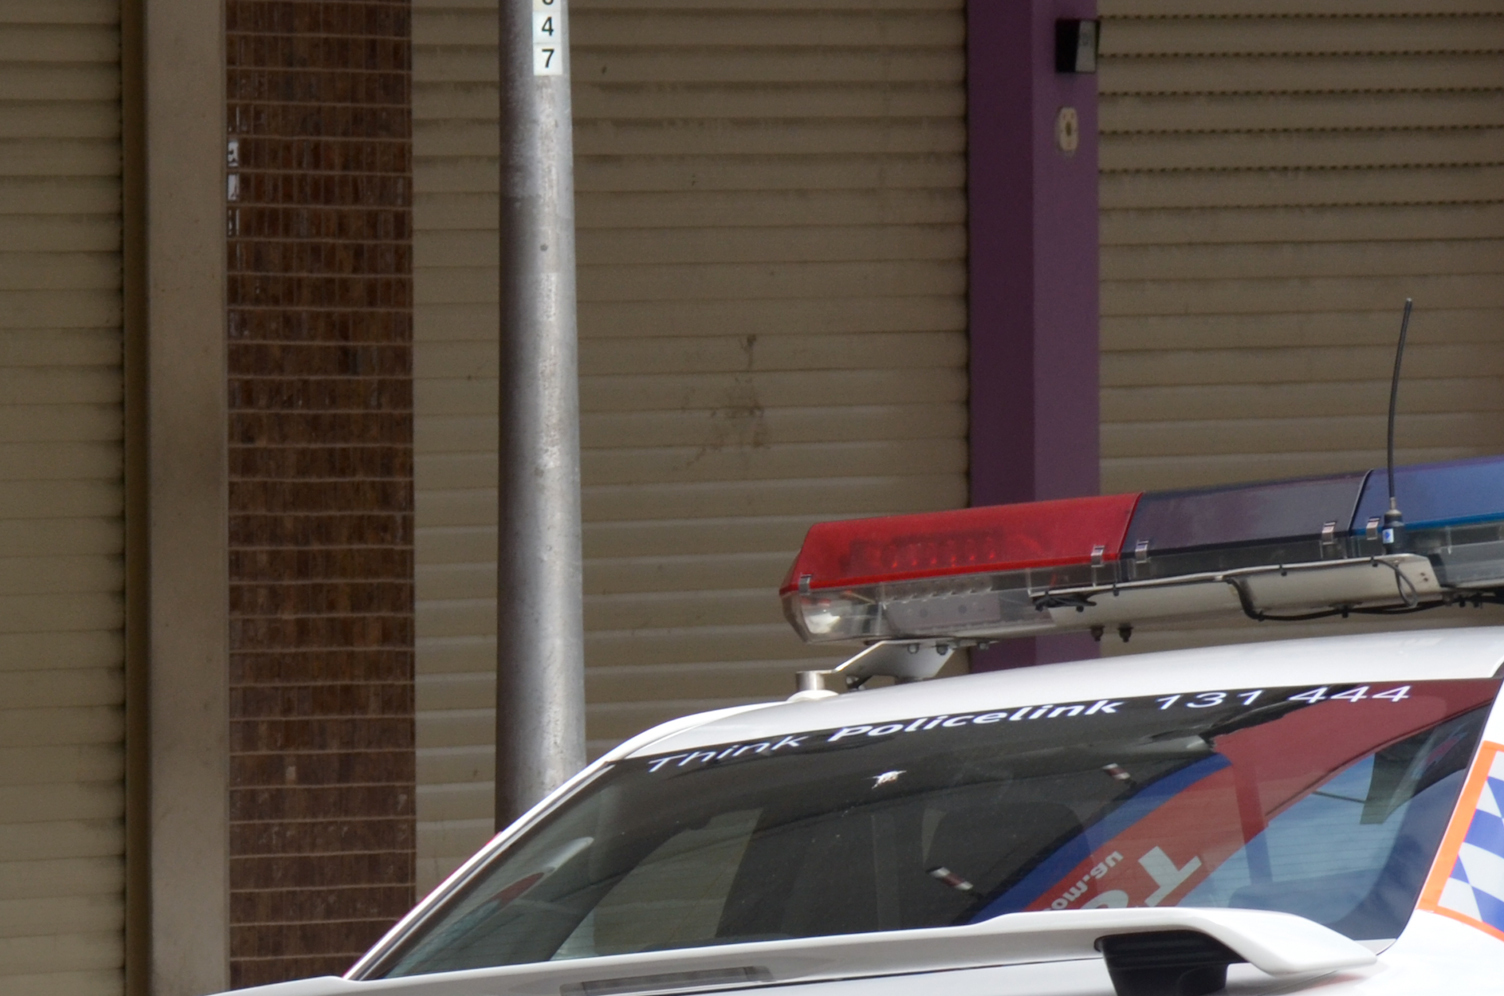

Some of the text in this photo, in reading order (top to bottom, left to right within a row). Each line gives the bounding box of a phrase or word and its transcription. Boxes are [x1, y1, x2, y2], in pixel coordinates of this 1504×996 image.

[648, 685, 1412, 773] Think Policelink 131 444
